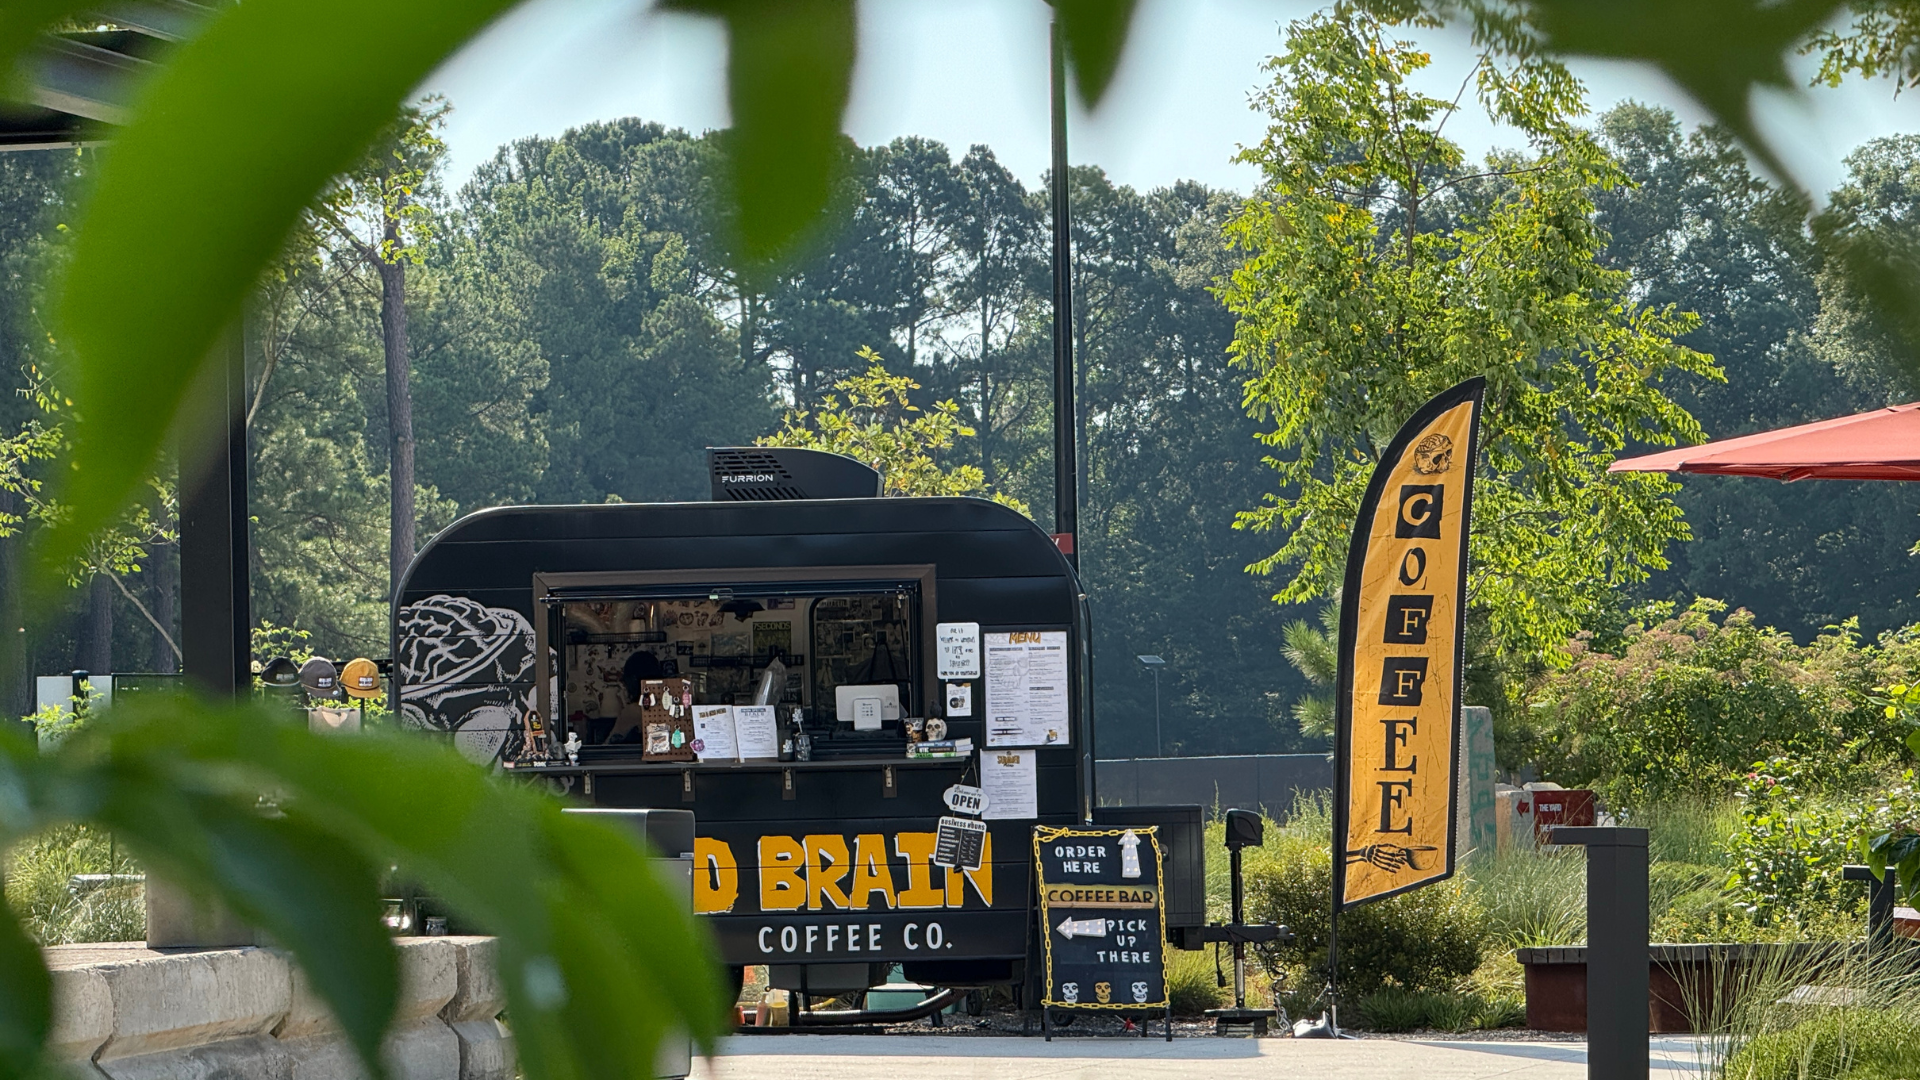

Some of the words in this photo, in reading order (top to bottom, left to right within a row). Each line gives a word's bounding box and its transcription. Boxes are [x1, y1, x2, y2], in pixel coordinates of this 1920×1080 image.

[721, 474, 774, 483] FURRION
[1008, 631, 1042, 644] MENU
[1375, 490, 1436, 837] COFFEE
[952, 793, 981, 809] OPEN
[1539, 803, 1549, 812] THE
[1549, 803, 1561, 812] YARD
[941, 818, 967, 829] BUSINESS
[967, 821, 985, 831] HOURS
[1054, 846, 1107, 858] ORDER
[757, 832, 992, 911] BRAIN
[1063, 861, 1100, 873] HERE
[1048, 890, 1114, 903] COFFEE
[1119, 890, 1154, 903] BAR
[1106, 920, 1147, 931] PICK
[758, 924, 881, 953] COFFEE
[903, 922, 953, 950] CO.
[1116, 935, 1137, 947] UP
[1096, 951, 1150, 963] THERE
